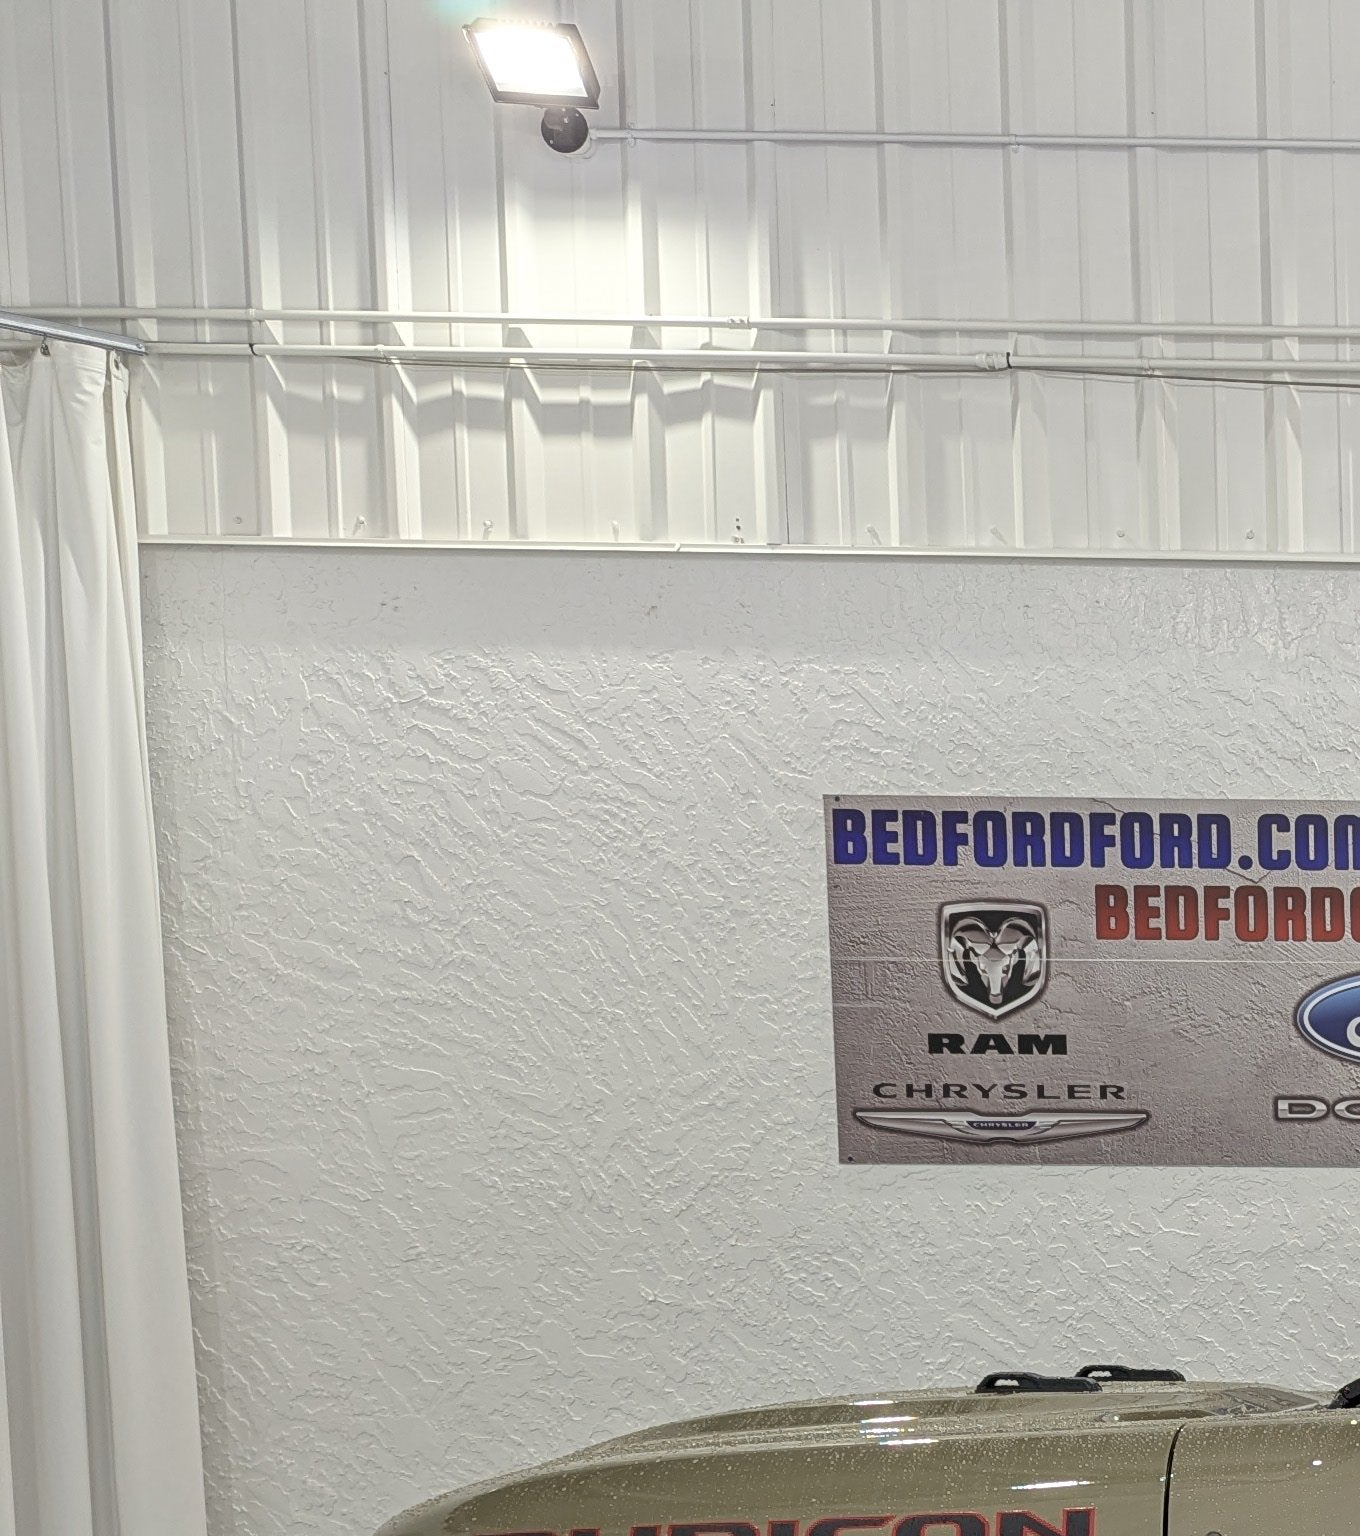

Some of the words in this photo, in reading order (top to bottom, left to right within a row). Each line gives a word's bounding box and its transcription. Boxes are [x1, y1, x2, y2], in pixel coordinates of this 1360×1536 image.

[927, 1032, 1068, 1056] RAM
[872, 1082, 1127, 1100] CHRYSLER
[972, 1121, 1030, 1129] CHRYSLER
